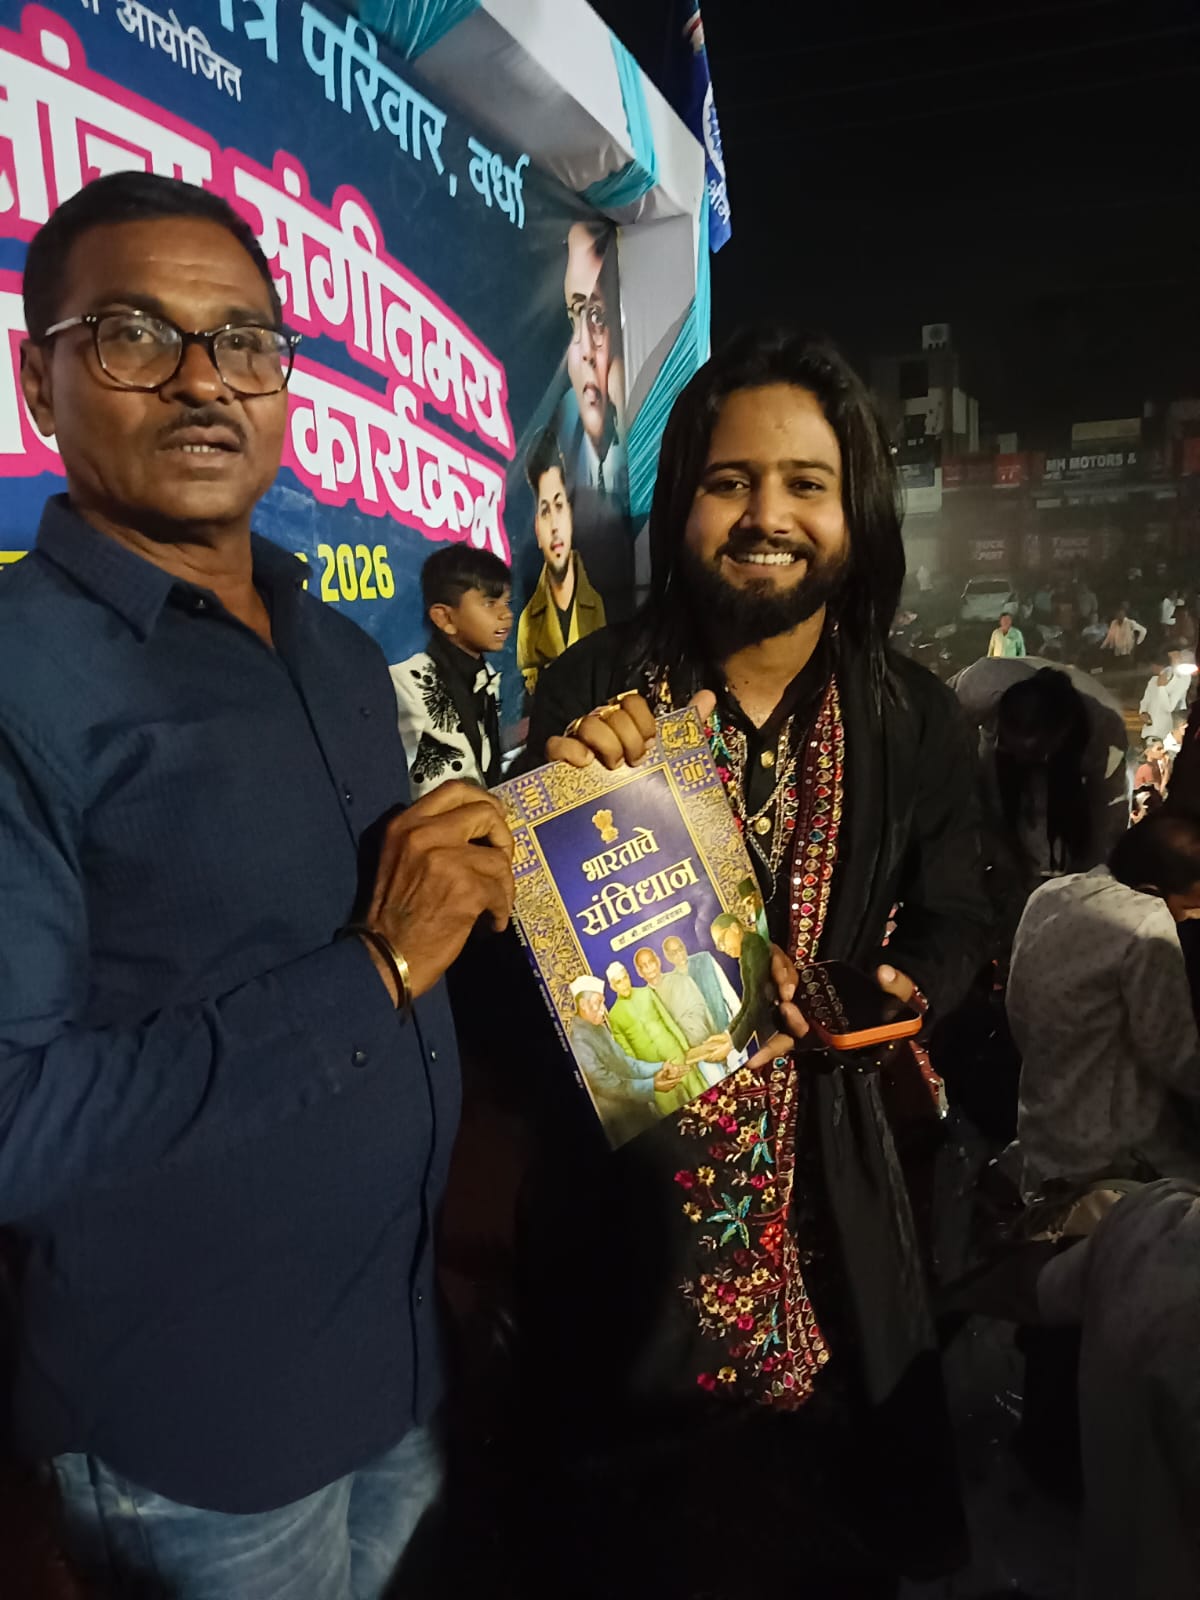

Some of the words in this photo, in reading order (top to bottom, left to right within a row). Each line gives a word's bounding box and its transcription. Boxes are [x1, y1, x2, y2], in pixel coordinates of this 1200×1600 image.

[116, 0, 242, 102] आयोजित
[467, 136, 530, 229] वर्धा
[233, 165, 511, 450] संगीतमय
[284, 365, 508, 562] कार्यक्रम
[1069, 453, 1123, 470] MOTORS
[1127, 452, 1137, 465] &
[317, 543, 395, 603] 2026
[576, 857, 699, 935] संविधान
[582, 827, 660, 882] भारताचे
